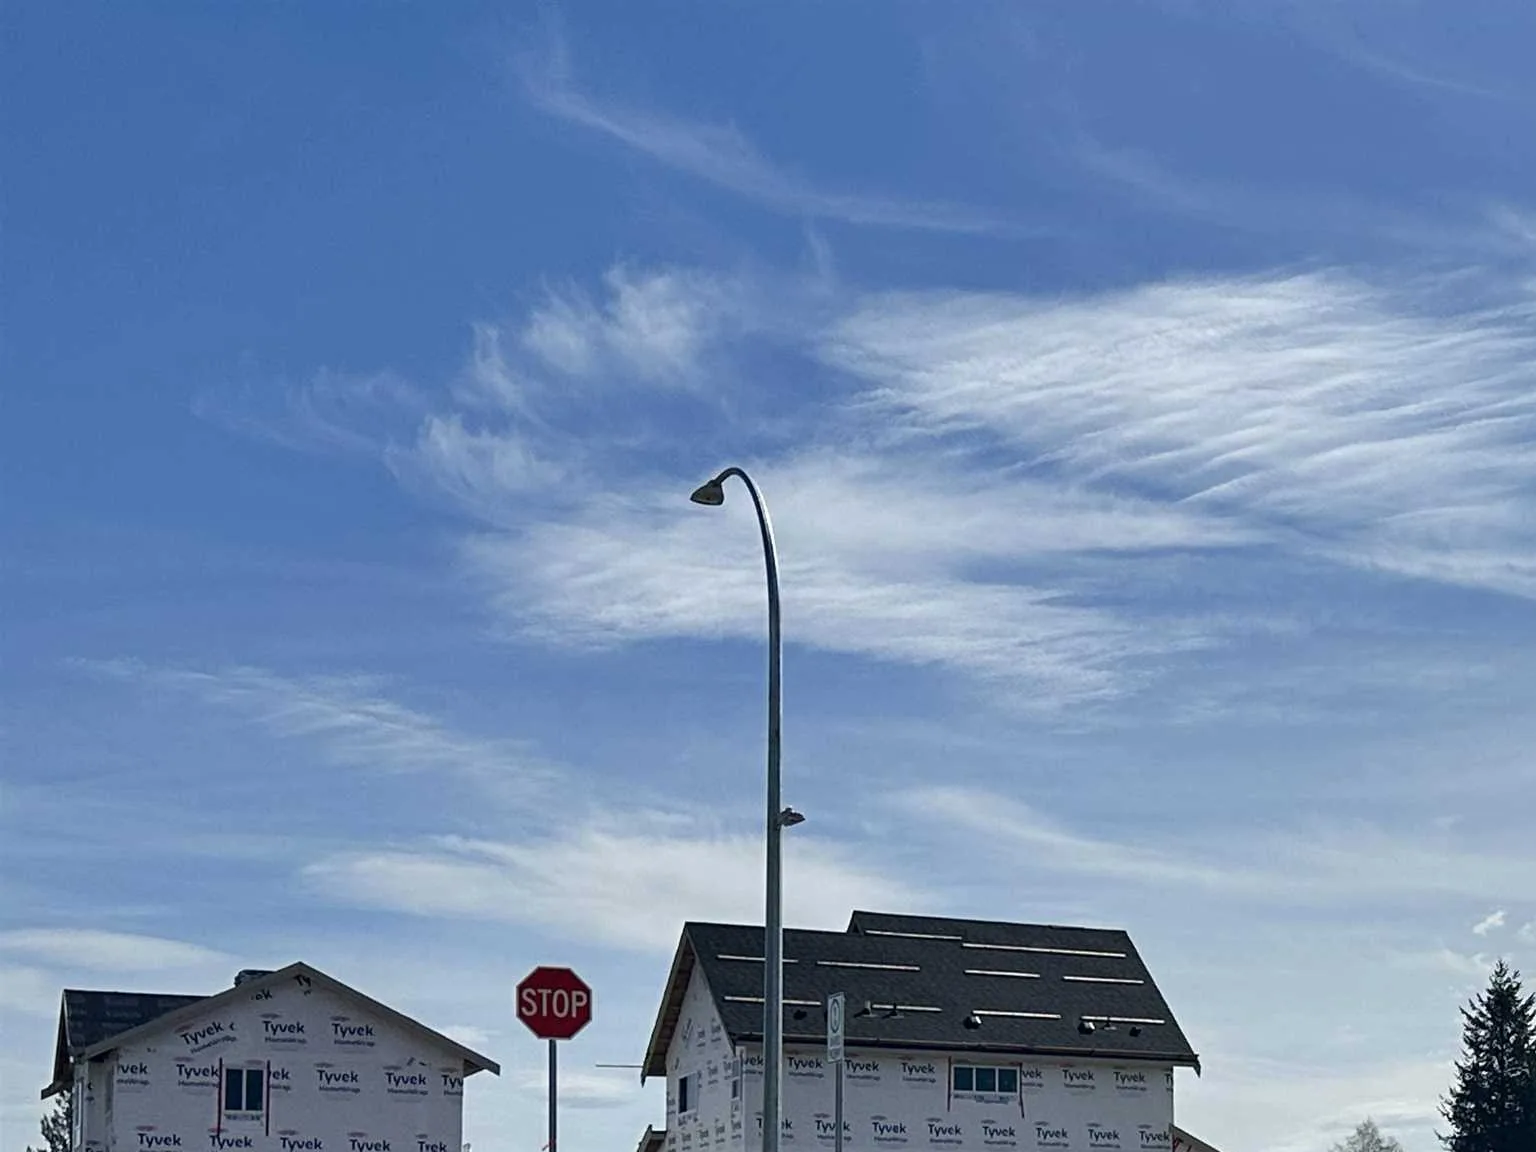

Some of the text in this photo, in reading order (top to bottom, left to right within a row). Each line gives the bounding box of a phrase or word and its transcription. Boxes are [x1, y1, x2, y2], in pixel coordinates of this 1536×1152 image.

[521, 988, 587, 1018] STOP
[182, 1021, 224, 1046] Tyvek
[262, 1020, 305, 1036] Tyvek
[332, 1023, 374, 1039] Tyvek
[745, 1056, 764, 1066] vek
[788, 1056, 824, 1069] Tyvek
[844, 1058, 880, 1072] Tyvek
[118, 1062, 149, 1075] vek
[176, 1063, 219, 1079] Tyvek
[902, 1062, 936, 1076] Tyvek
[1021, 1069, 1043, 1079] vek
[1062, 1069, 1096, 1082] Tyvek
[317, 1069, 360, 1085] Tyvek
[385, 1072, 427, 1088] Tyvek
[441, 1075, 463, 1089] Tyv
[1113, 1071, 1147, 1084] Tyvek
[815, 1119, 850, 1133] Tyvk
[872, 1121, 907, 1135] Tyvek
[928, 1123, 962, 1137] Tyvek
[982, 1125, 1016, 1139] Tyvek
[138, 1132, 182, 1149] Tyvek
[1035, 1127, 1069, 1140] Tyvek
[1088, 1129, 1120, 1141] Tyvek
[1138, 1130, 1170, 1143] Tyvek
[209, 1135, 253, 1150] Tyvek
[280, 1137, 323, 1152] Tyvek
